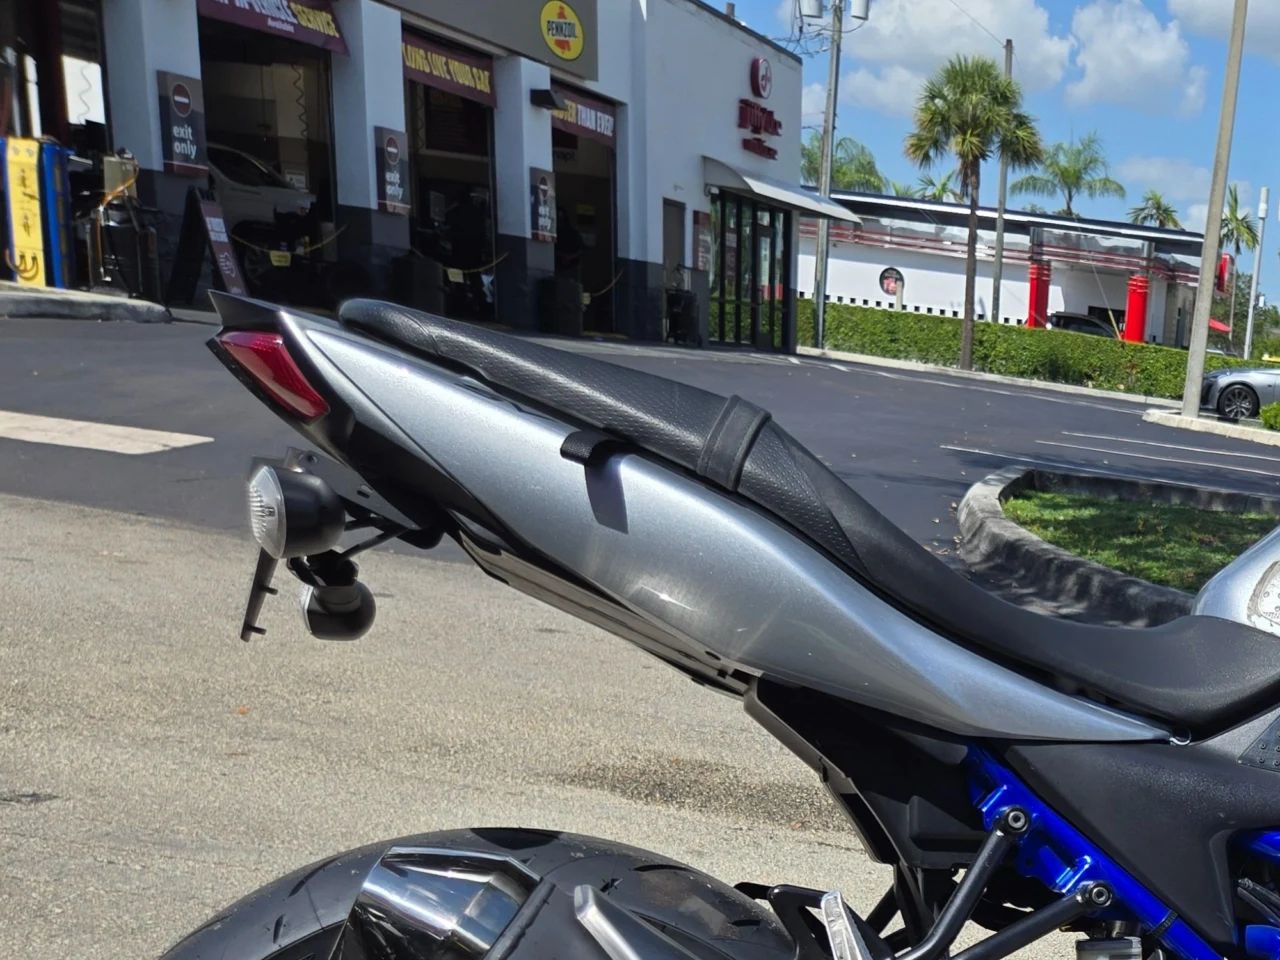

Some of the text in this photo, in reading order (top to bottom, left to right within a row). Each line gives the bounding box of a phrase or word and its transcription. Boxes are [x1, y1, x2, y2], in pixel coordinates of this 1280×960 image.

[546, 19, 578, 39] PENNZOIL
[427, 51, 451, 80] LIVE
[447, 58, 475, 88] YOUR
[472, 66, 490, 93] CAR
[577, 103, 597, 131] THAN
[172, 124, 193, 140] exit
[173, 140, 197, 160] only
[385, 170, 401, 184] exit
[386, 183, 404, 200] only
